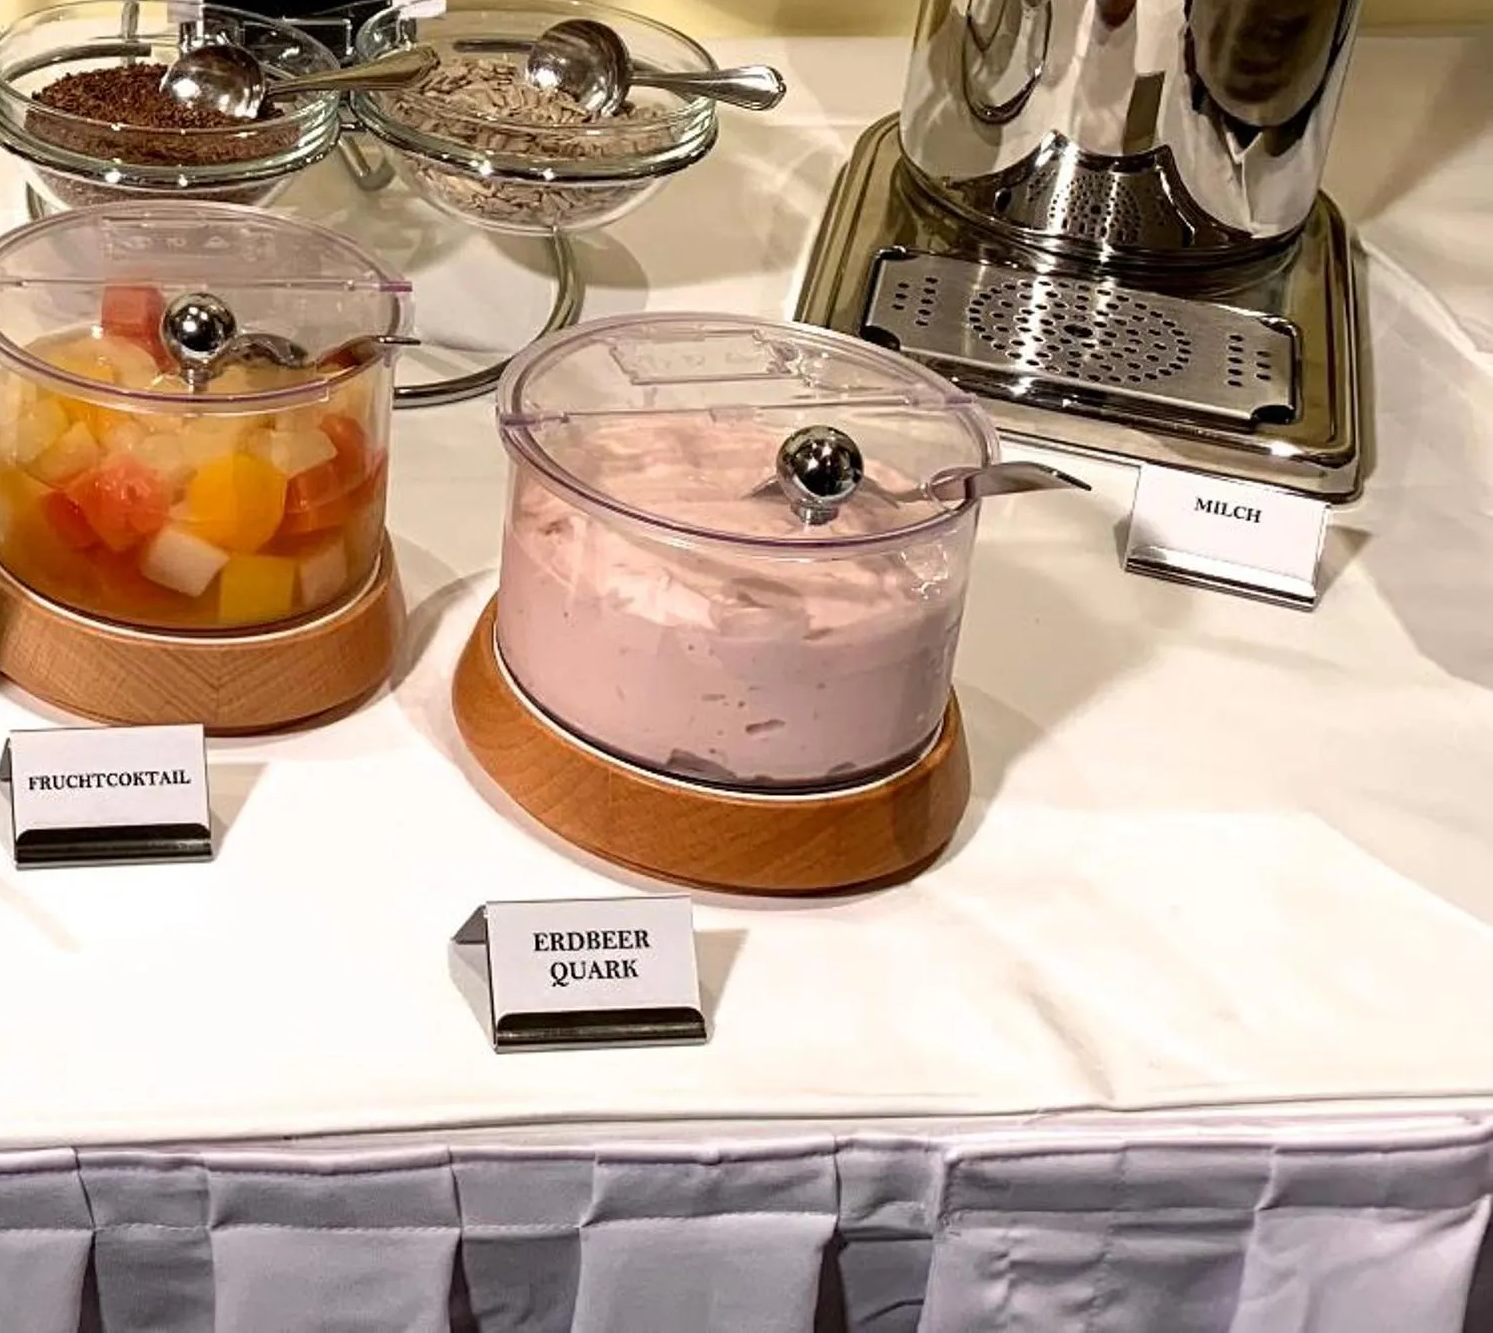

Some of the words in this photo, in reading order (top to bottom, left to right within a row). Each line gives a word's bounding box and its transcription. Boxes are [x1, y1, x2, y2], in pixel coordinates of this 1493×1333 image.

[1194, 496, 1262, 523] MILCH
[28, 769, 191, 791] FRUCHTCOKTAIL
[533, 929, 650, 951] ERDBEER
[550, 958, 639, 987] QUARK
